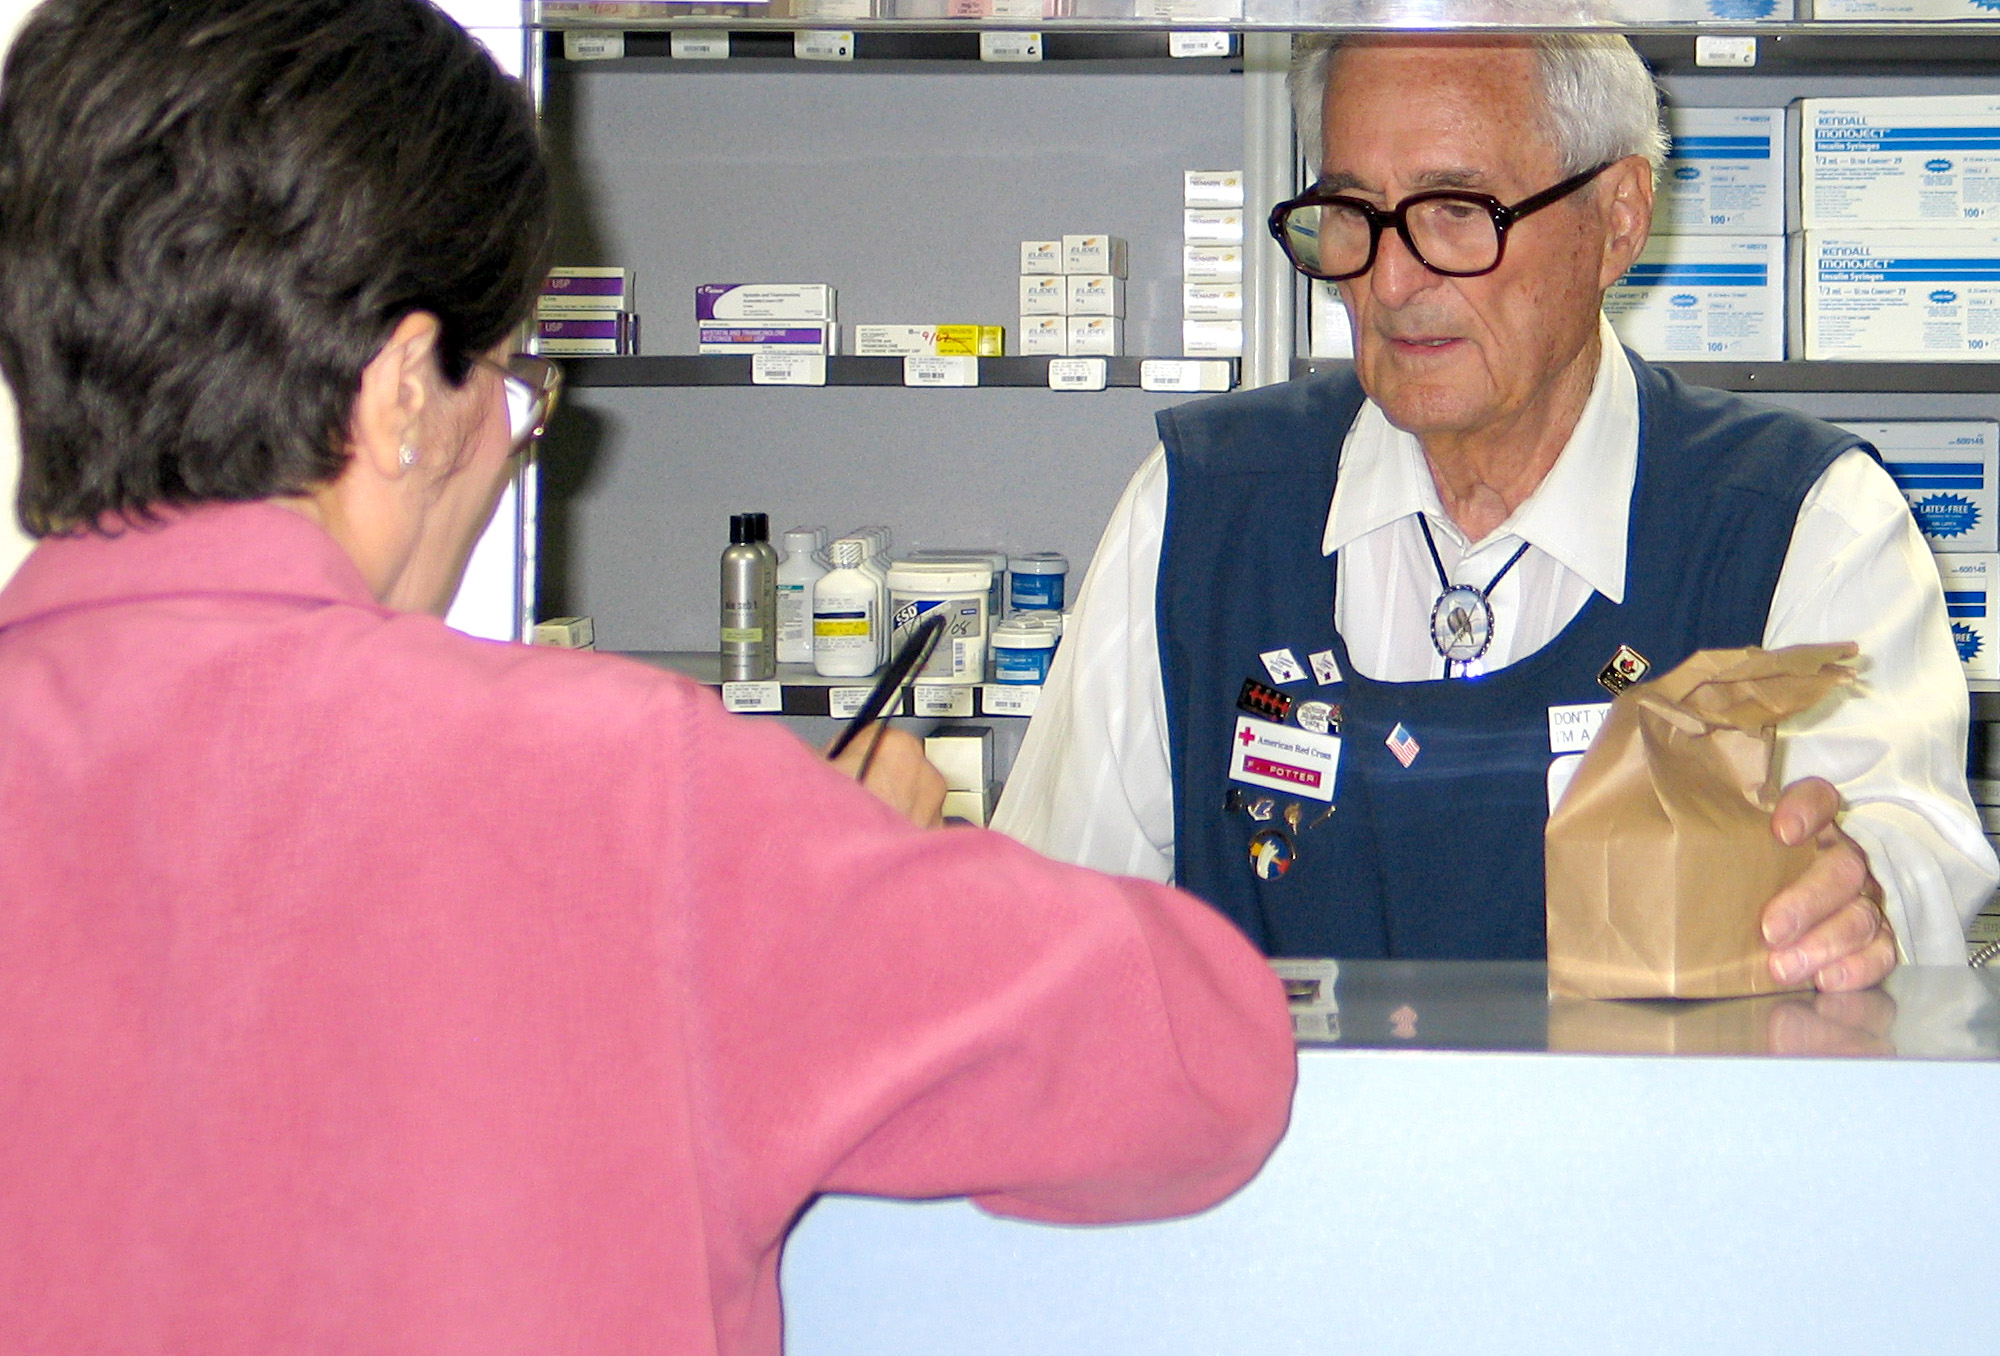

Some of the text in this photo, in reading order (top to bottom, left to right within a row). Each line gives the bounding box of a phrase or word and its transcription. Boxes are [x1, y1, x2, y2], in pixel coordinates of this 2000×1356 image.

[1819, 117, 1867, 126] KENDALL
[1818, 142, 1880, 152] Insulin Syringes
[1964, 208, 1979, 218] 100
[1711, 216, 1725, 225] 100
[1822, 247, 1870, 256] KENDALL
[1849, 273, 1884, 282] Syringes
[552, 279, 571, 288] USP
[545, 323, 564, 332] USP
[1707, 342, 1723, 352] 100
[1968, 340, 1983, 350] 100
[1920, 505, 1968, 513] LATEX-FREE
[896, 605, 918, 622] SSD
[1554, 709, 1591, 726] DON'T
[1555, 729, 1591, 743] I'M A
[1257, 736, 1331, 760] American Red Cross
[1269, 765, 1315, 783] POTTER
